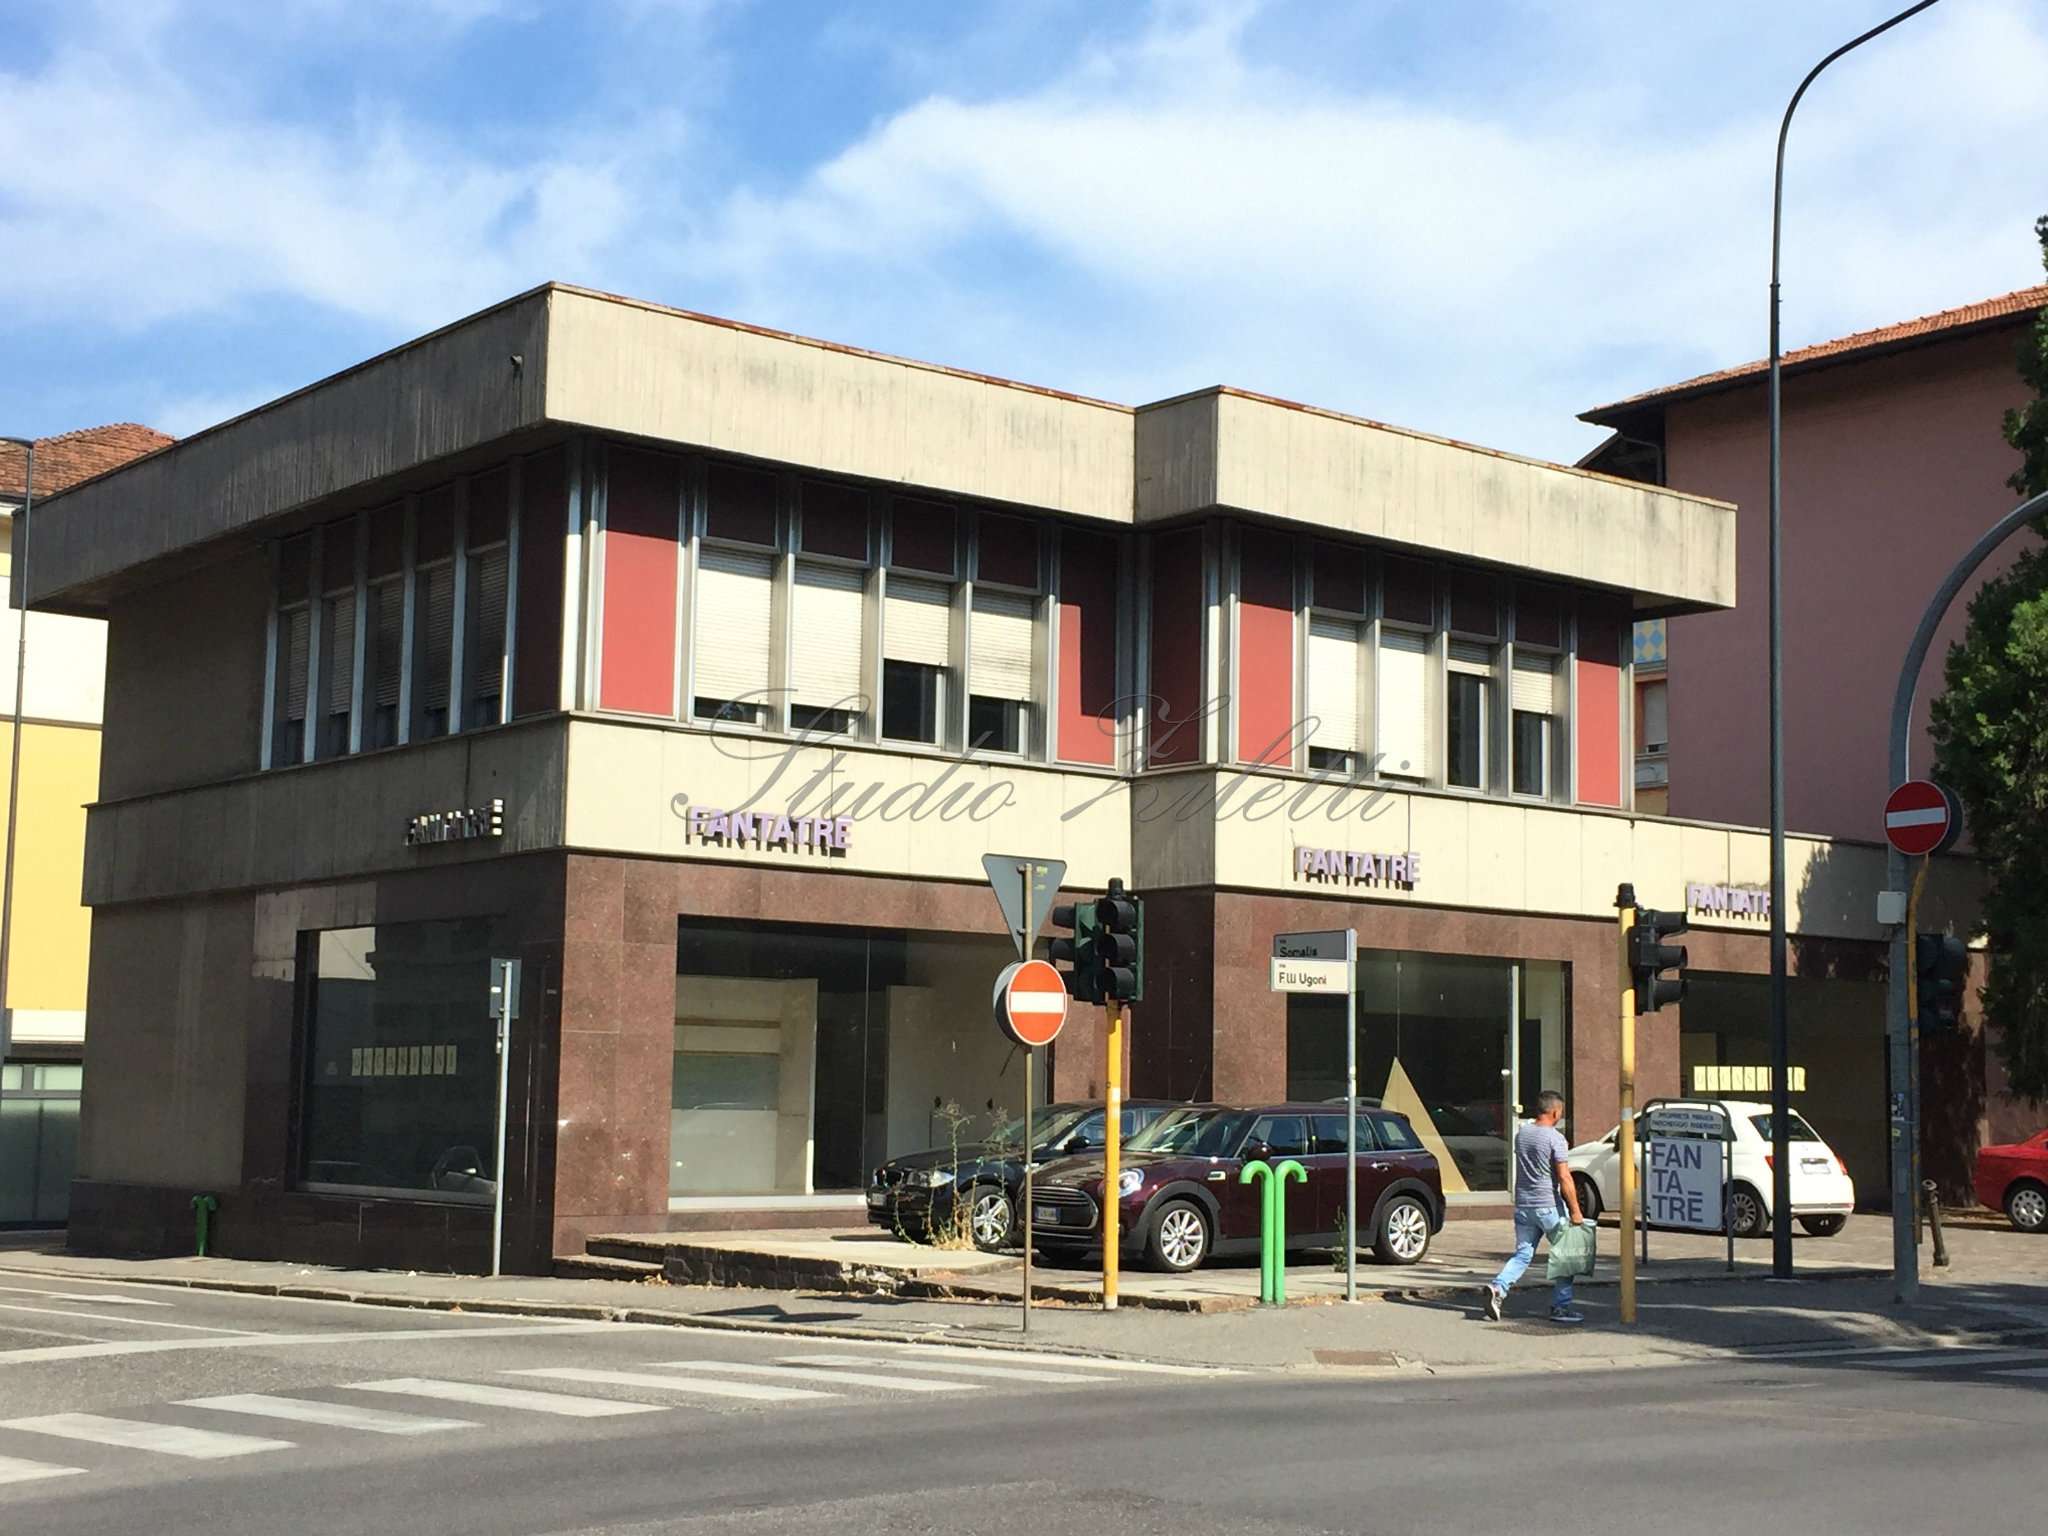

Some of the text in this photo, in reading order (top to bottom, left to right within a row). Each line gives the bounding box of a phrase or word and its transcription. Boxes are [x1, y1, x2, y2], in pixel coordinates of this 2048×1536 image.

[1299, 972, 1327, 987] Ugoni
[1651, 1143, 1701, 1170] FAN
[1652, 1169, 1683, 1195] TA
